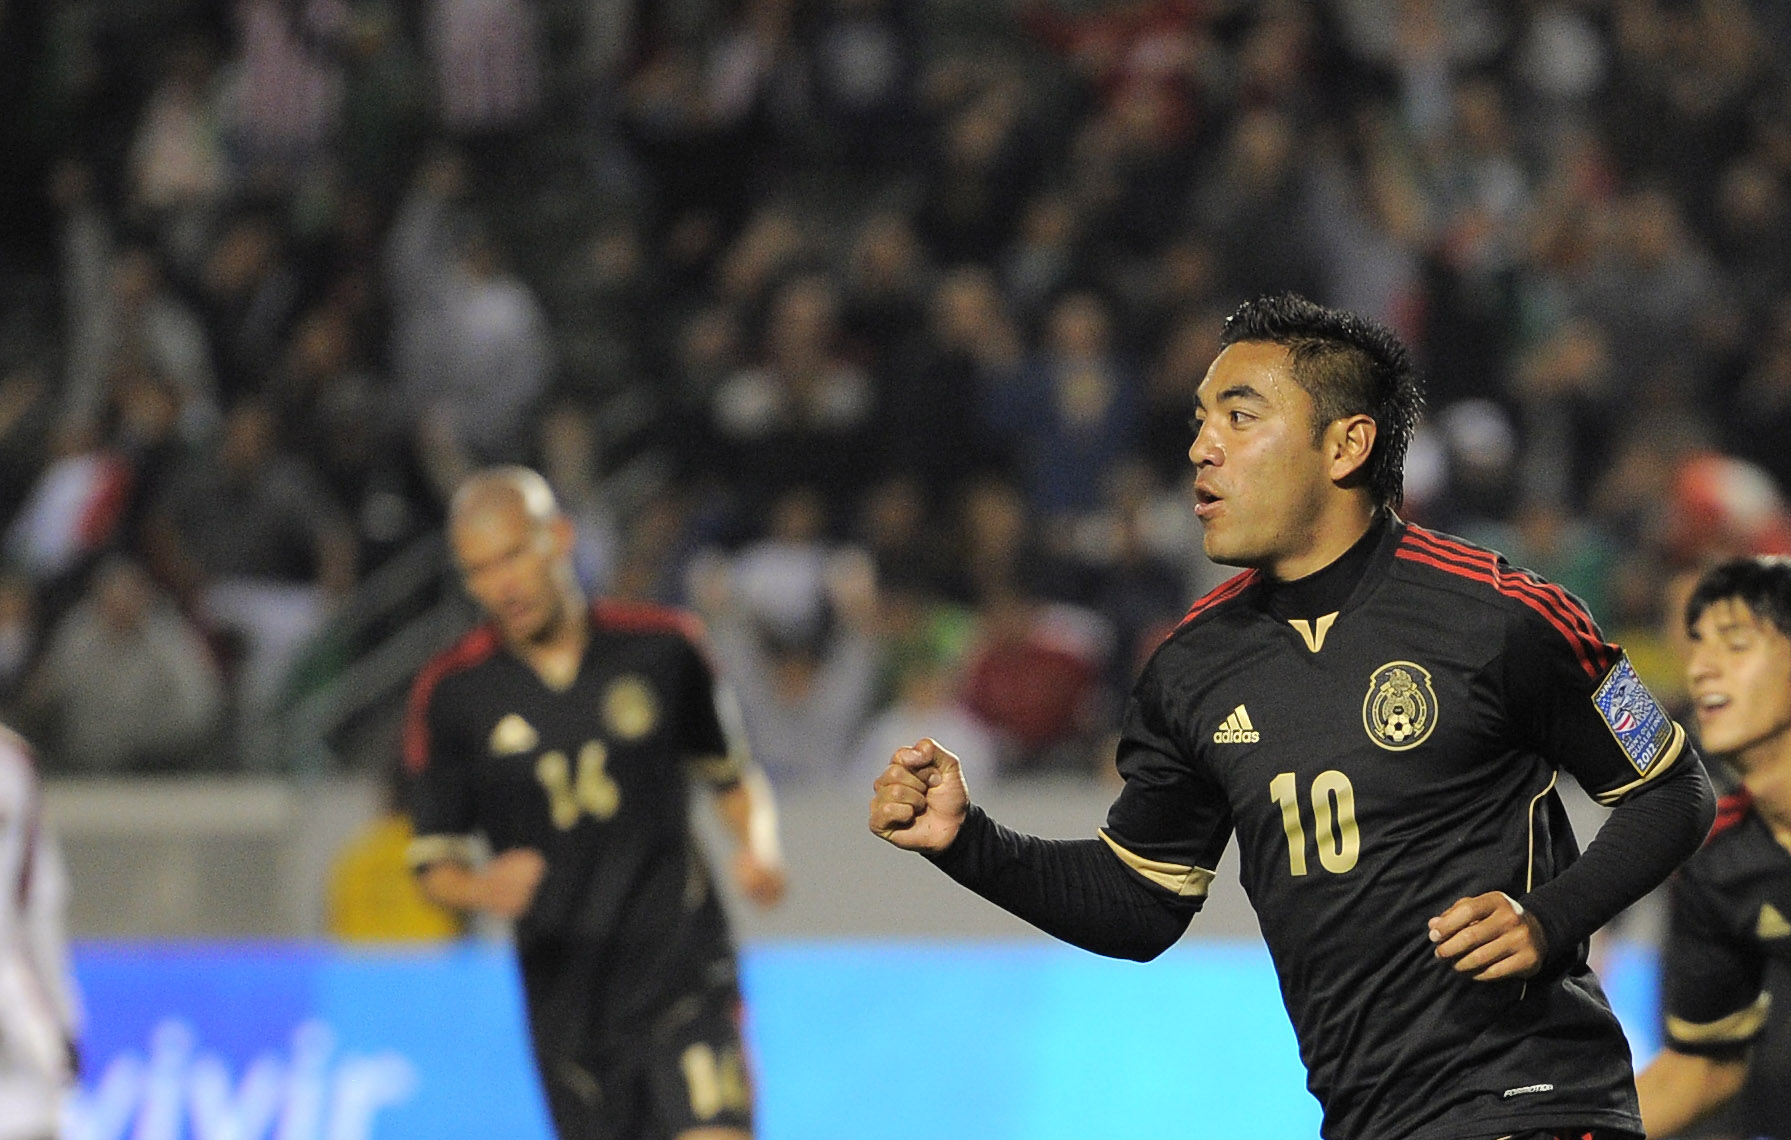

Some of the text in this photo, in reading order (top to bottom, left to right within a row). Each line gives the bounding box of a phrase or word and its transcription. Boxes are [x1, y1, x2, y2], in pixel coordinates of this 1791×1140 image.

[1213, 729, 1260, 743] adidas
[1636, 743, 1657, 770] 2012
[1269, 770, 1360, 876] 10
